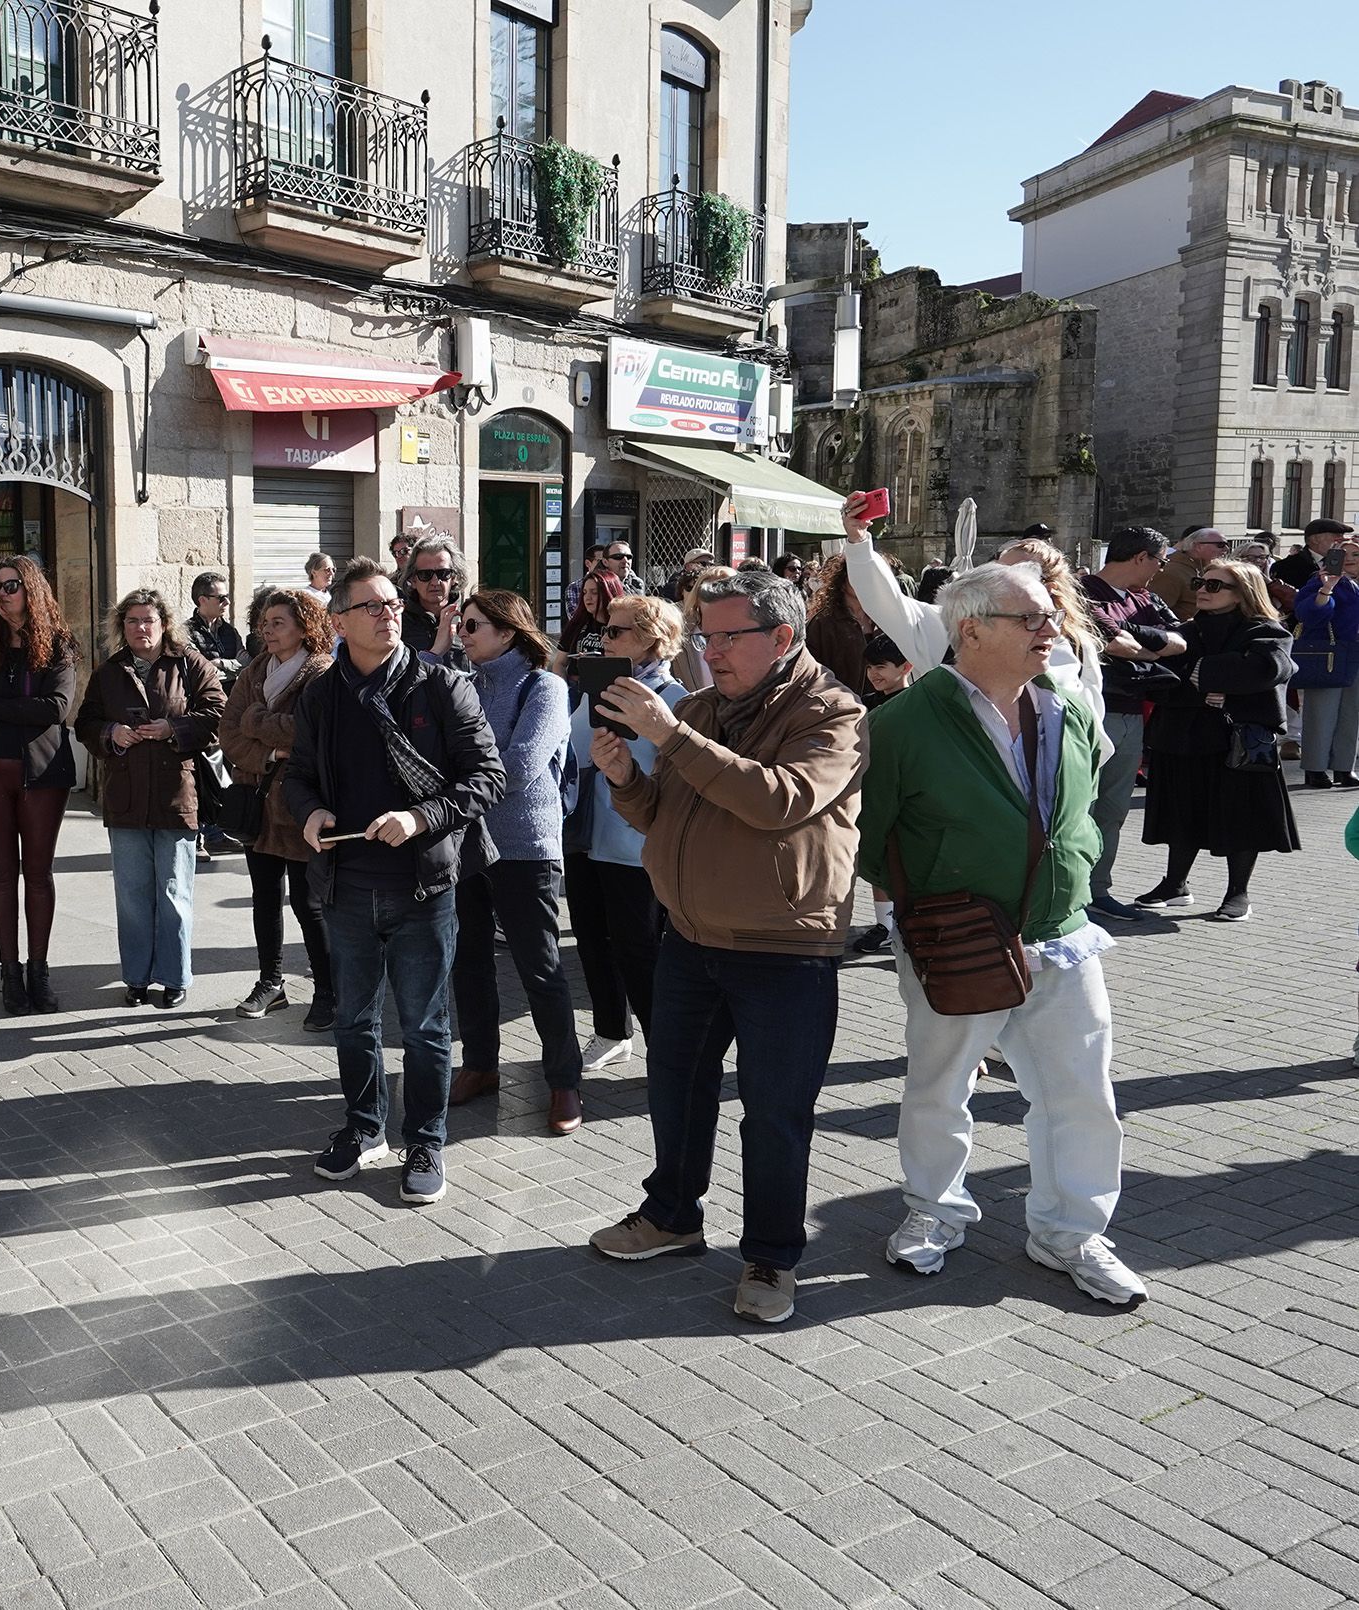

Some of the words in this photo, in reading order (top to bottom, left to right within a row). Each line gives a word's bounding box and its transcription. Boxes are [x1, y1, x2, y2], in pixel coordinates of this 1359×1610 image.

[660, 393, 695, 408] REVELADO
[695, 398, 713, 411] FOTO
[713, 401, 736, 414] DIGITAL
[750, 415, 762, 425] FOTO
[494, 430, 515, 440] PLAZA
[517, 432, 525, 441] DE
[527, 432, 551, 444] ESPAÑA
[285, 448, 346, 465] TABACOS
